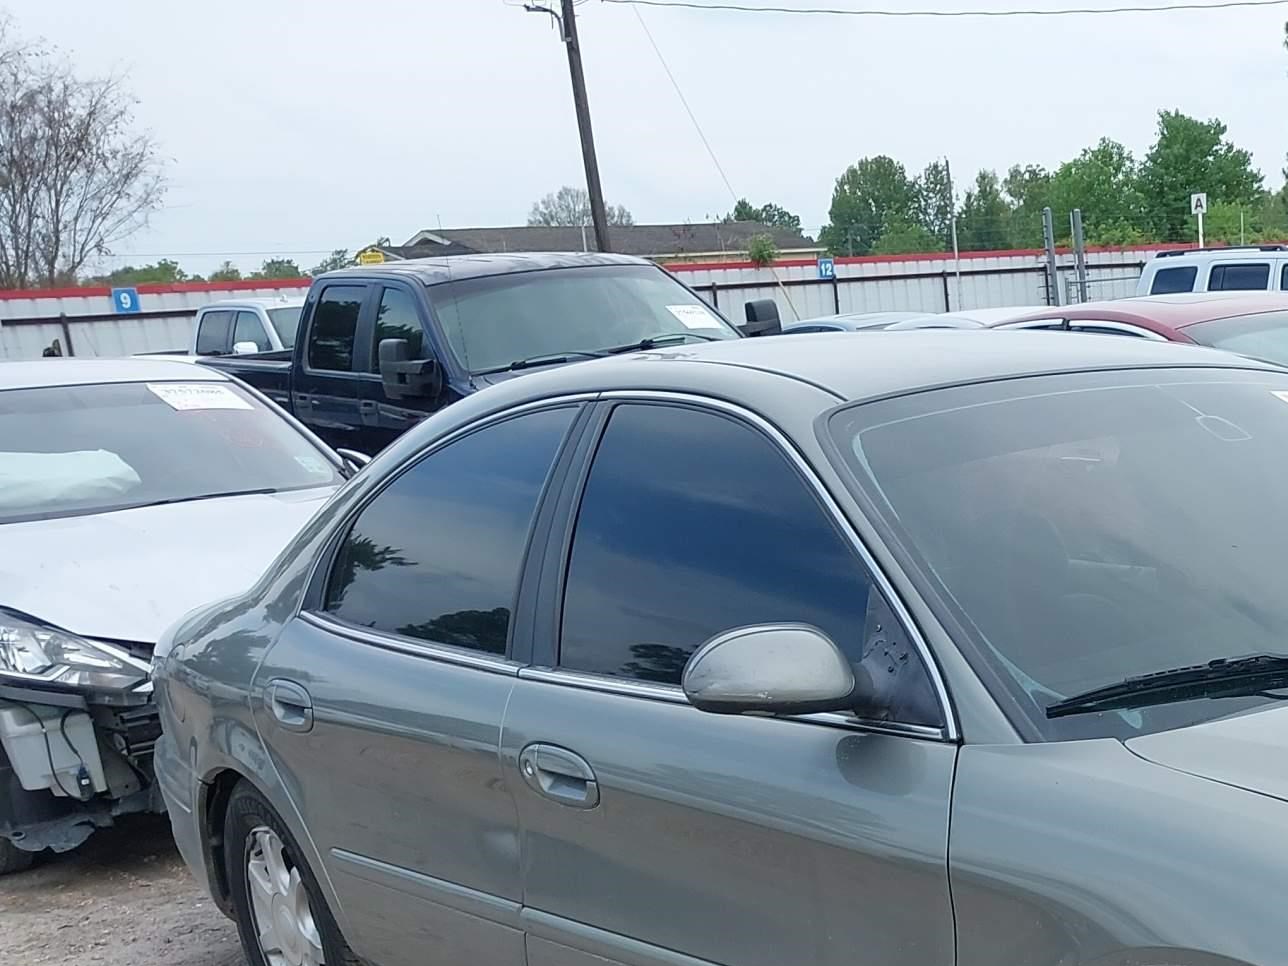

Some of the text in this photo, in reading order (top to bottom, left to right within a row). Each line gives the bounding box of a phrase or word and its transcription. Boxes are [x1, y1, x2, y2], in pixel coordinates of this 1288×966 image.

[1194, 197, 1204, 210] A
[820, 263, 833, 276] 12
[119, 292, 132, 309] 9
